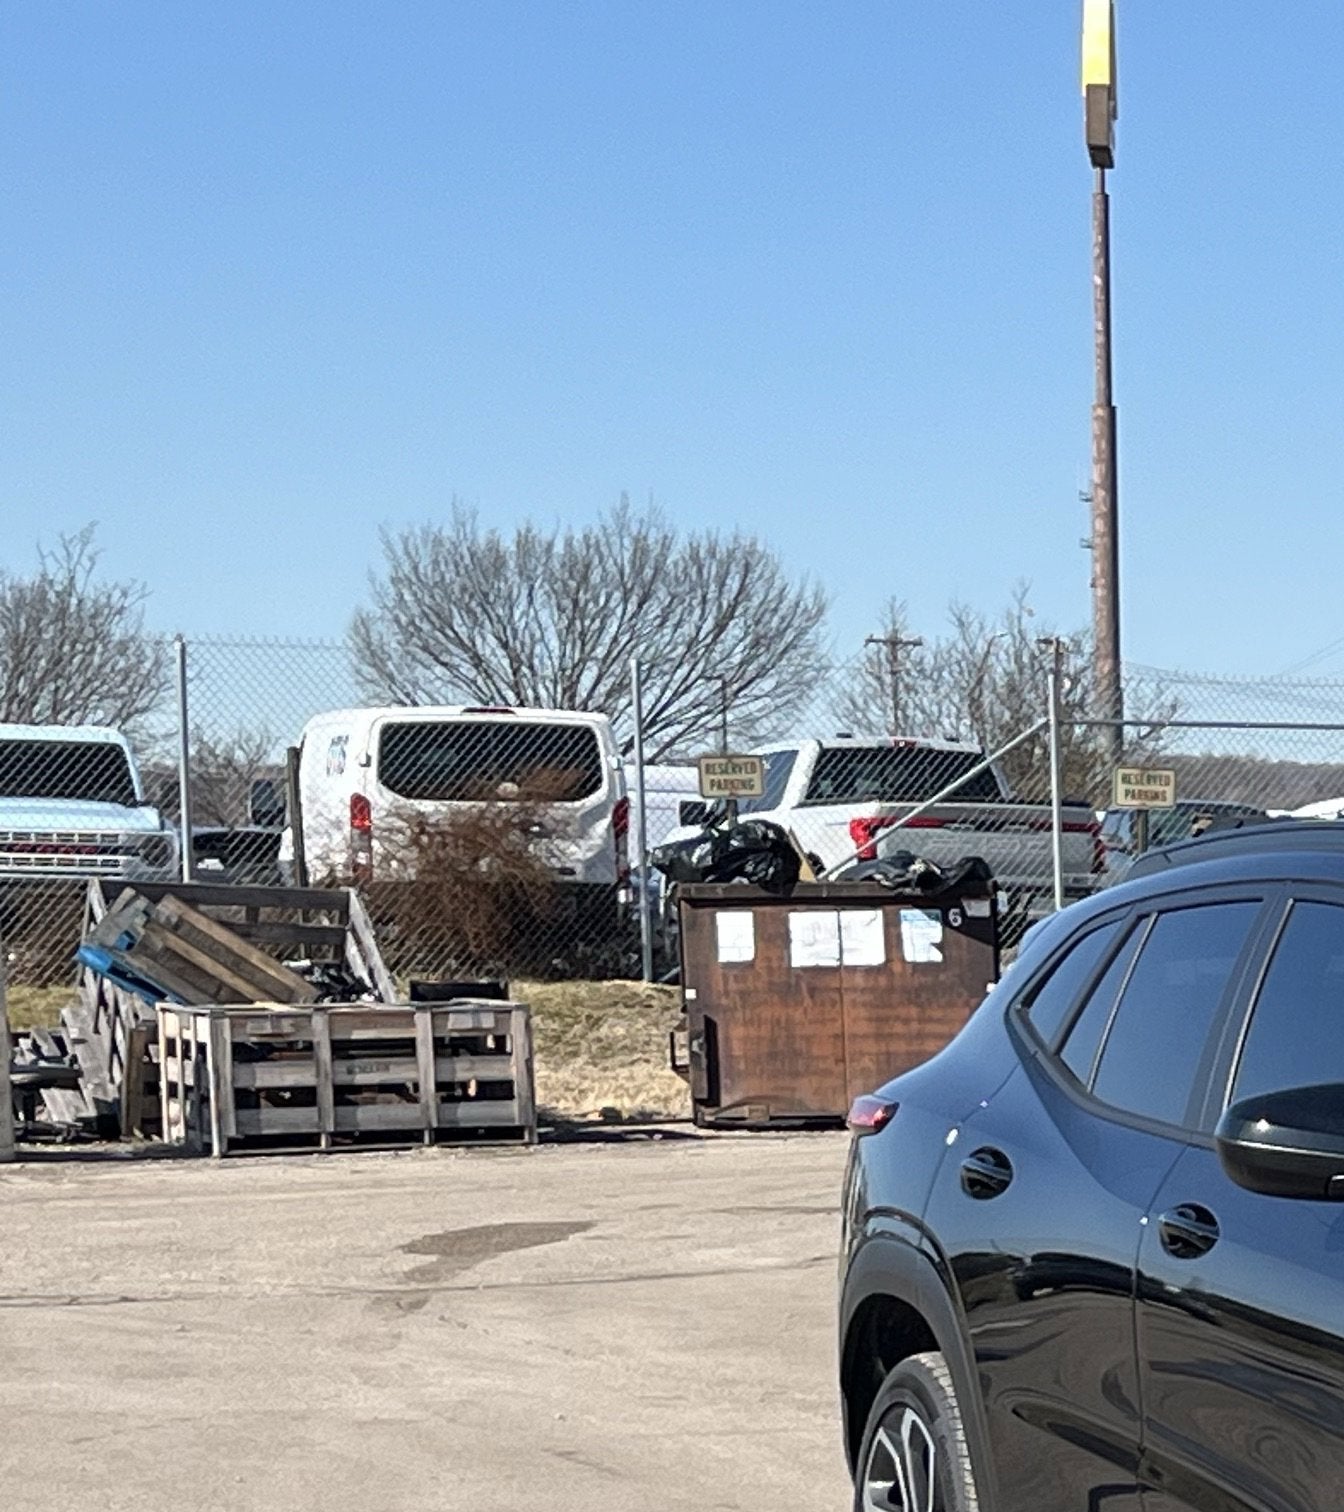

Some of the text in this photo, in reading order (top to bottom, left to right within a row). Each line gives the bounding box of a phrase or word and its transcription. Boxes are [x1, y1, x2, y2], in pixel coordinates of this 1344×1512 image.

[705, 762, 757, 774] RESERVED
[710, 778, 754, 790] PARKING
[1121, 774, 1171, 787] RESERVED
[1125, 788, 1167, 802] PARKING
